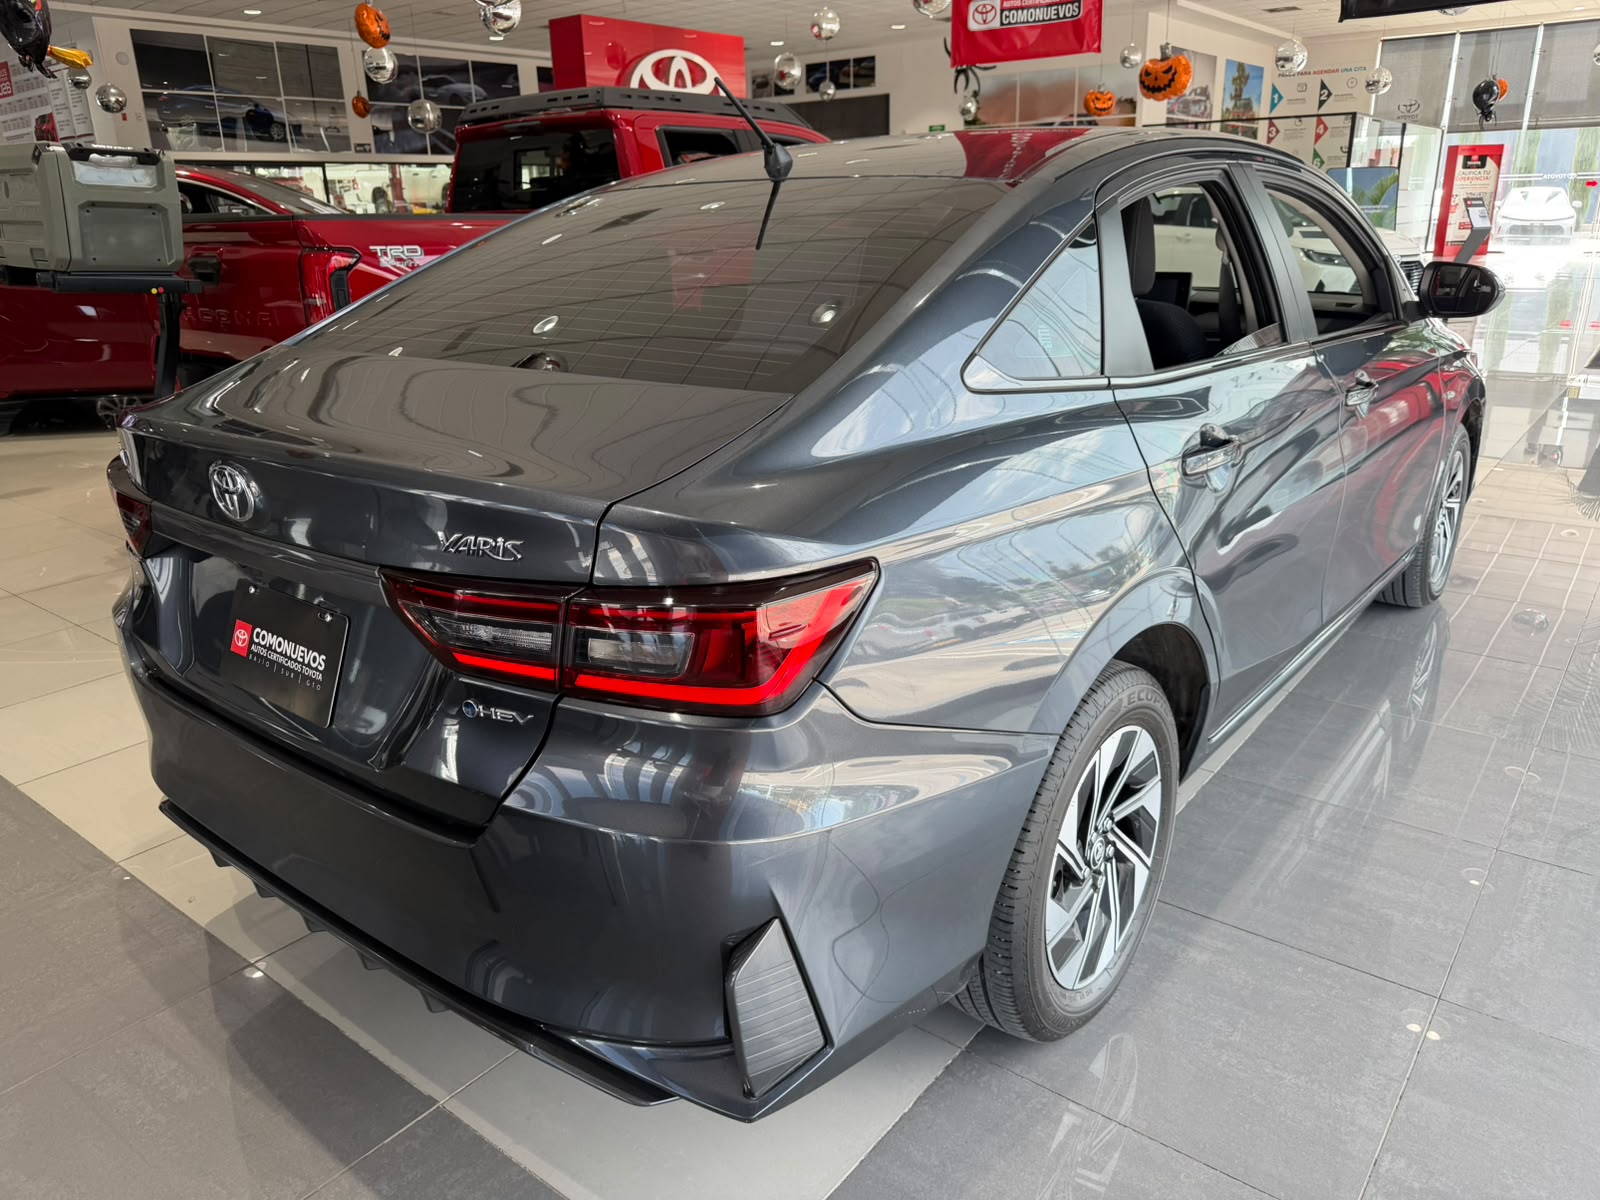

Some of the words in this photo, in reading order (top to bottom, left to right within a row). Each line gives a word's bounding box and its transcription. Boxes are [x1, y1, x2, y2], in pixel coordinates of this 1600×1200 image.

[1001, 3, 1079, 24] COMONUEVOS
[1273, 94, 1278, 103] 1
[1320, 89, 1328, 100] 2
[1268, 127, 1276, 138] 3
[1317, 124, 1324, 134] 4
[369, 245, 424, 259] TRD
[437, 531, 523, 560] YARIS
[253, 627, 326, 671] COMONUEVOS
[250, 644, 267, 656] AUTOS
[267, 651, 302, 672] CERTIFICADOS
[302, 665, 322, 681] TOYOTA
[281, 668, 294, 678] SUR
[306, 680, 321, 691] GTO
[478, 704, 534, 725] HEV
